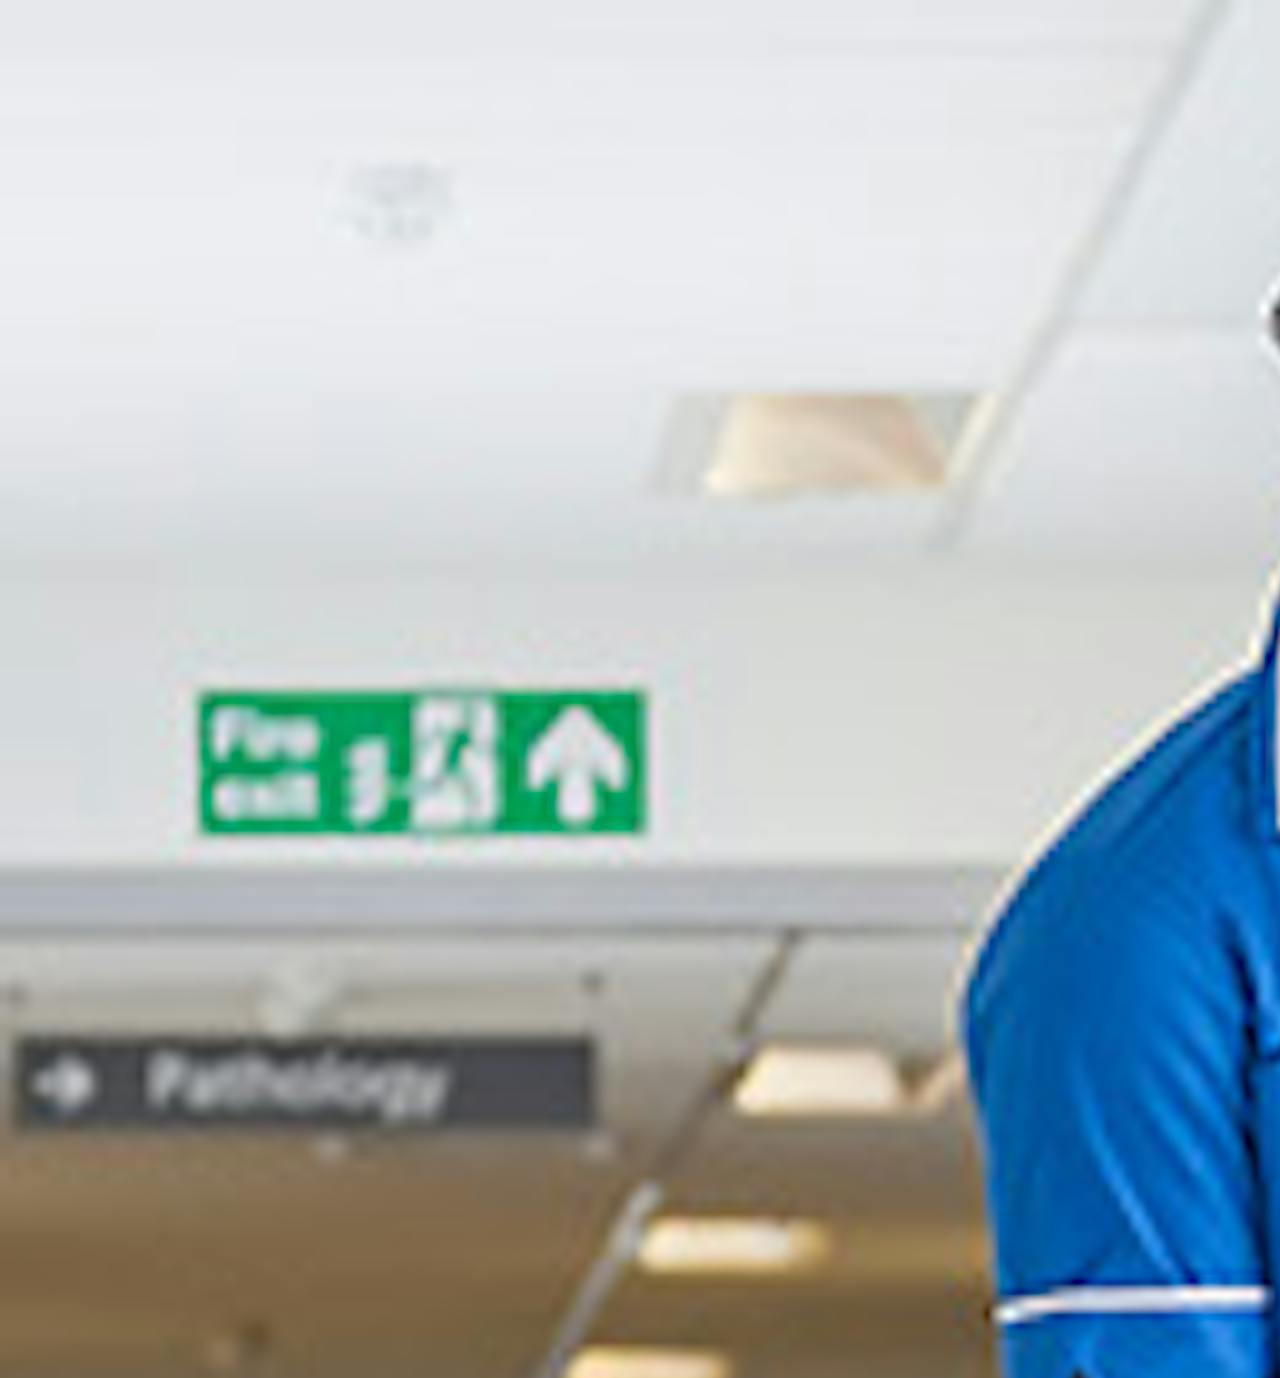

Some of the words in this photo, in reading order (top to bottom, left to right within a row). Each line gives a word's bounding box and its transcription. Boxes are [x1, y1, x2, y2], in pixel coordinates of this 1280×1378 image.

[210, 705, 320, 762] Fire
[211, 770, 319, 821] exit
[146, 1049, 451, 1121] Pathology
